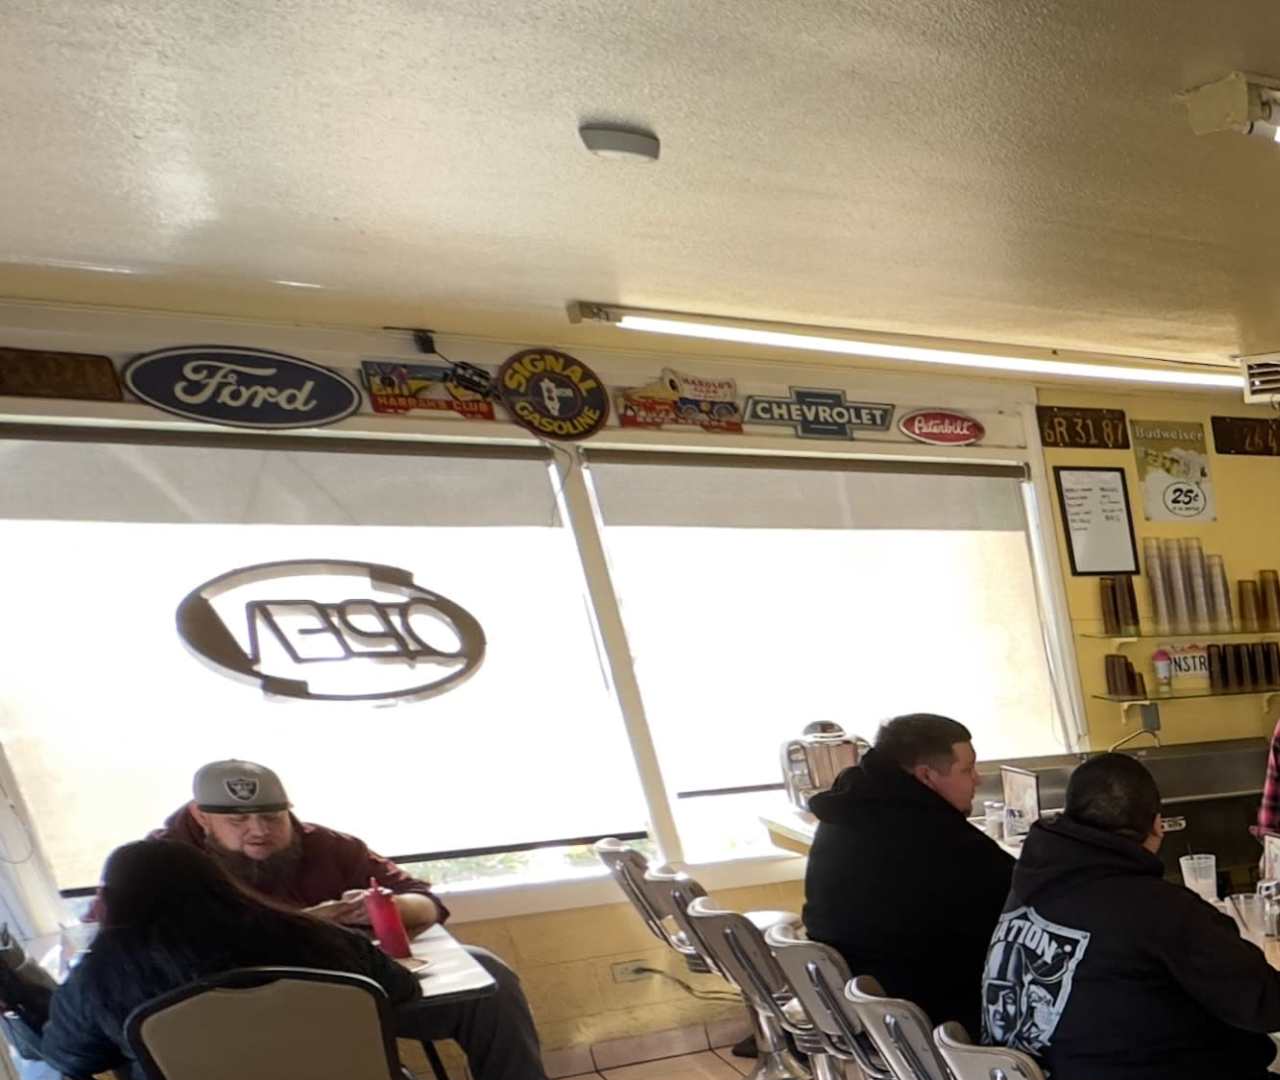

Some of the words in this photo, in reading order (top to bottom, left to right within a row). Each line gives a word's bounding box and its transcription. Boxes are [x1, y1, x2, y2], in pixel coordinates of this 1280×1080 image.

[174, 360, 318, 412] Ford
[504, 353, 598, 397] SIGNAL
[451, 400, 490, 414] CLUB
[514, 401, 600, 435] GASOLINE
[755, 402, 885, 425] CHEVROLET
[913, 416, 972, 436] Peterbilt
[1135, 425, 1205, 441] Budweiser
